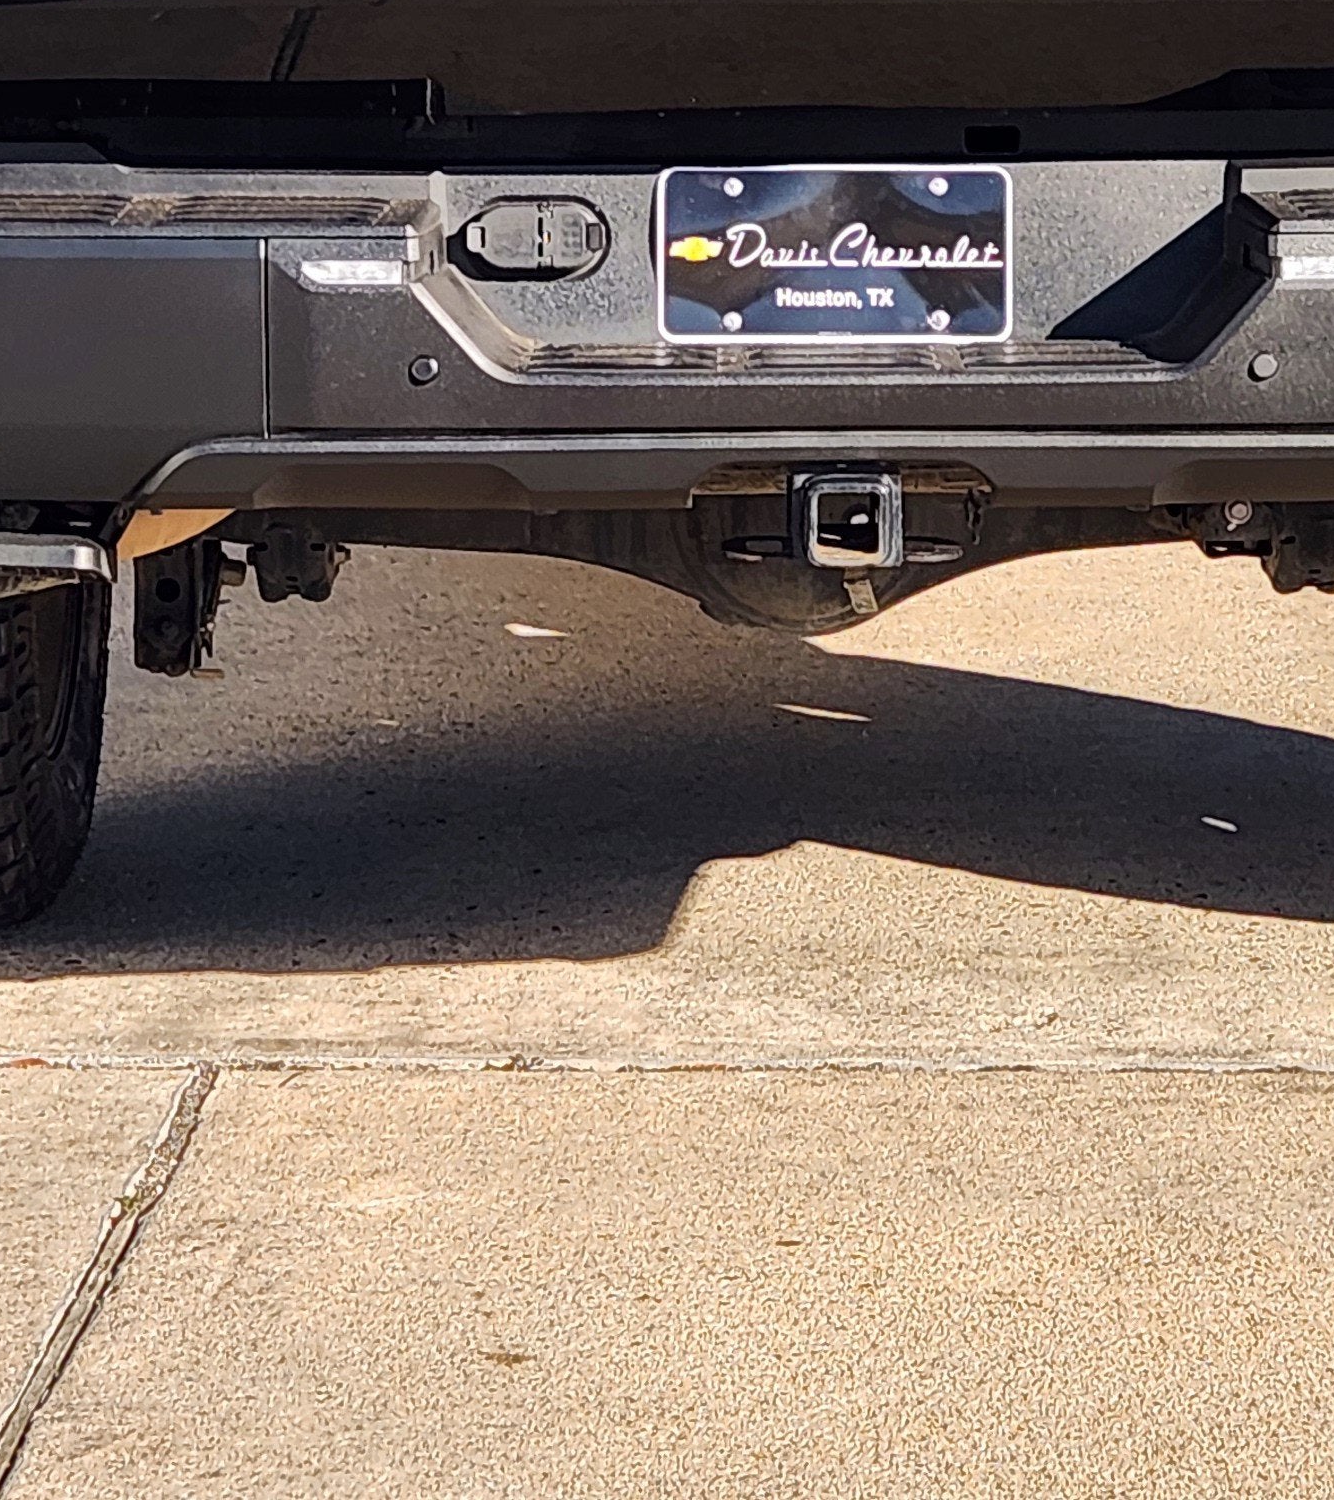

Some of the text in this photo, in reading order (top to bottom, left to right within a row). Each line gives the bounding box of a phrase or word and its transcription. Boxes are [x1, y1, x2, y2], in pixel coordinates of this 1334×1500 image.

[726, 222, 1004, 268] Davis Chevrolet
[775, 286, 895, 310] Houston, TX
